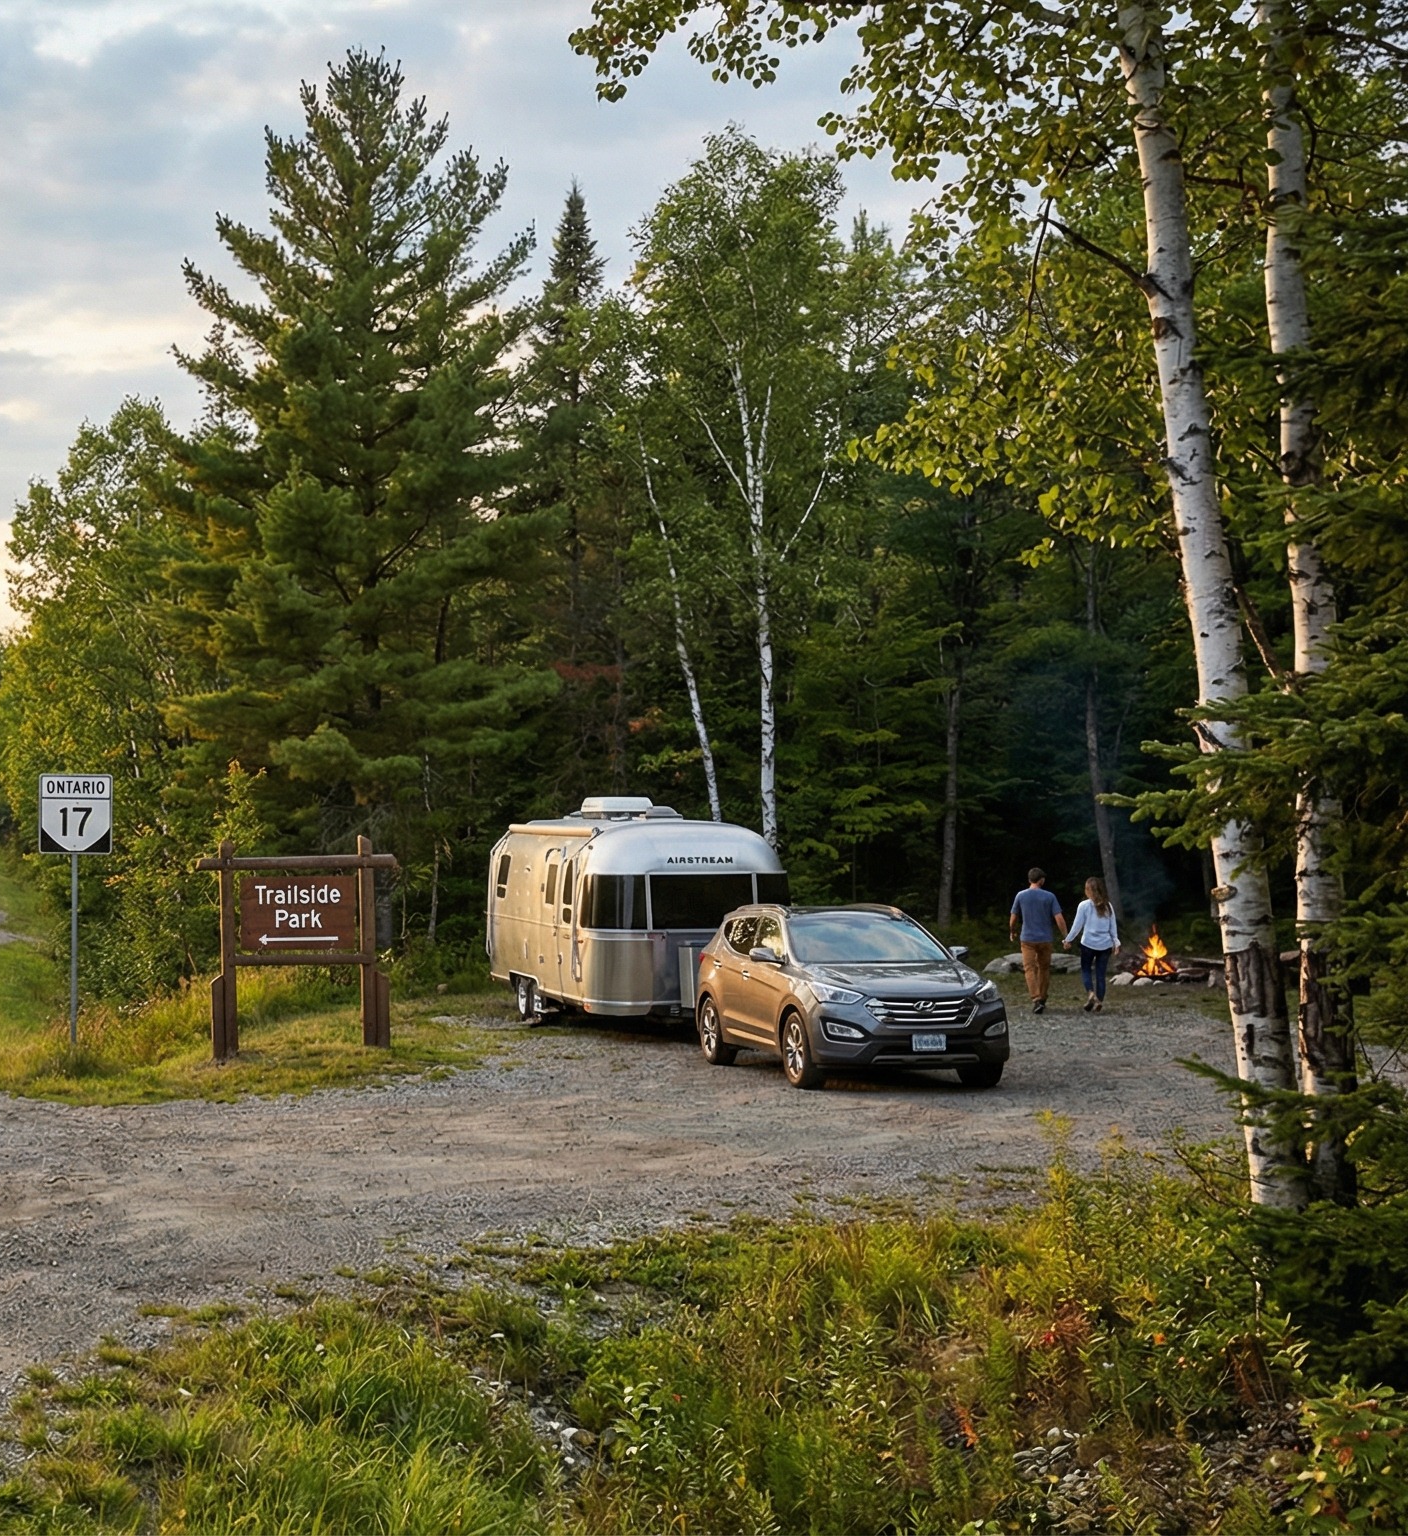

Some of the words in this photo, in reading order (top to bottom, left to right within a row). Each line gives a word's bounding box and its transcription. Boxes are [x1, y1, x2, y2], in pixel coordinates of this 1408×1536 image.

[47, 780, 105, 794] ONTARIO
[59, 807, 93, 837] 17
[667, 856, 734, 864] AIRSTREAM
[255, 885, 341, 905] Trailside
[275, 909, 323, 929] Park
